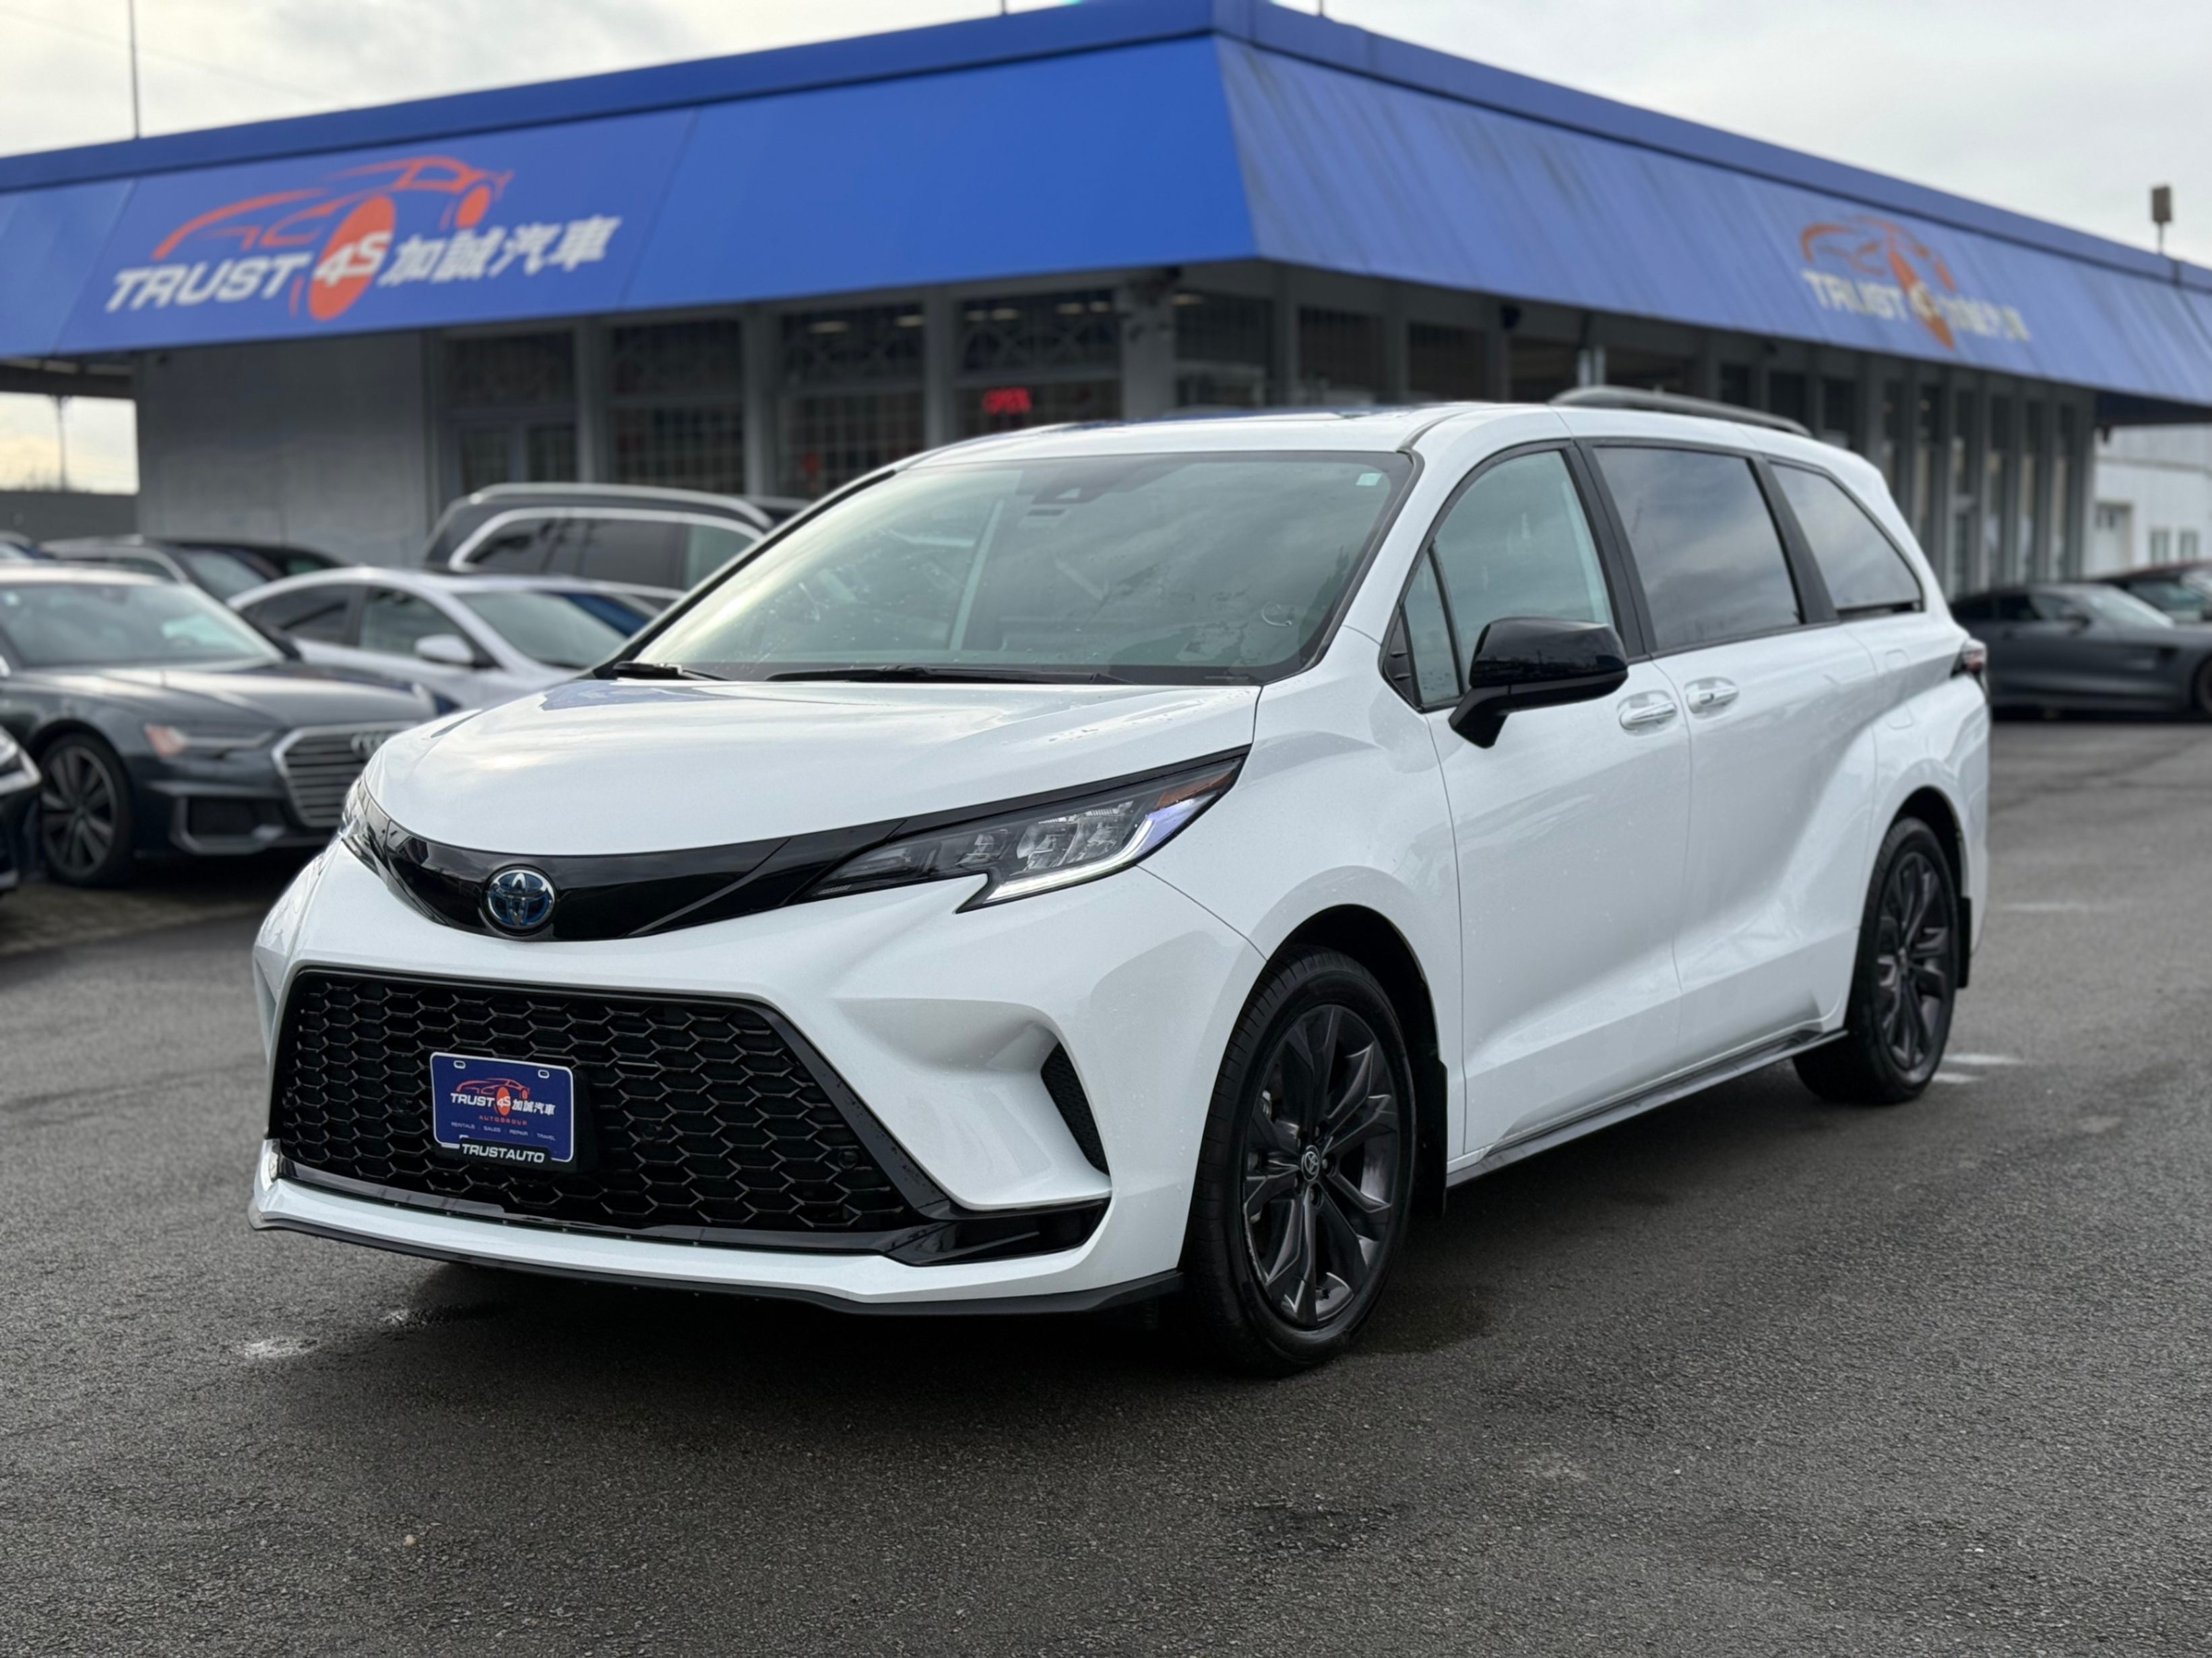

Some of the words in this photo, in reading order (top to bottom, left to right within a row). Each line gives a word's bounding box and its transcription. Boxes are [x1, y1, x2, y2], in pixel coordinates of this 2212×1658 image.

[106, 251, 313, 312] TRUST
[313, 230, 392, 287] 4S
[450, 1093, 495, 1107] TRUST
[497, 1095, 511, 1108] 4S
[478, 1115, 528, 1126] AUTOGROUP
[451, 1121, 475, 1130] RENTALS
[483, 1125, 501, 1133] SALES
[509, 1128, 528, 1137] REPAIR
[536, 1133, 556, 1141] TRAVEL
[462, 1143, 545, 1163] TRUSTAUTO
